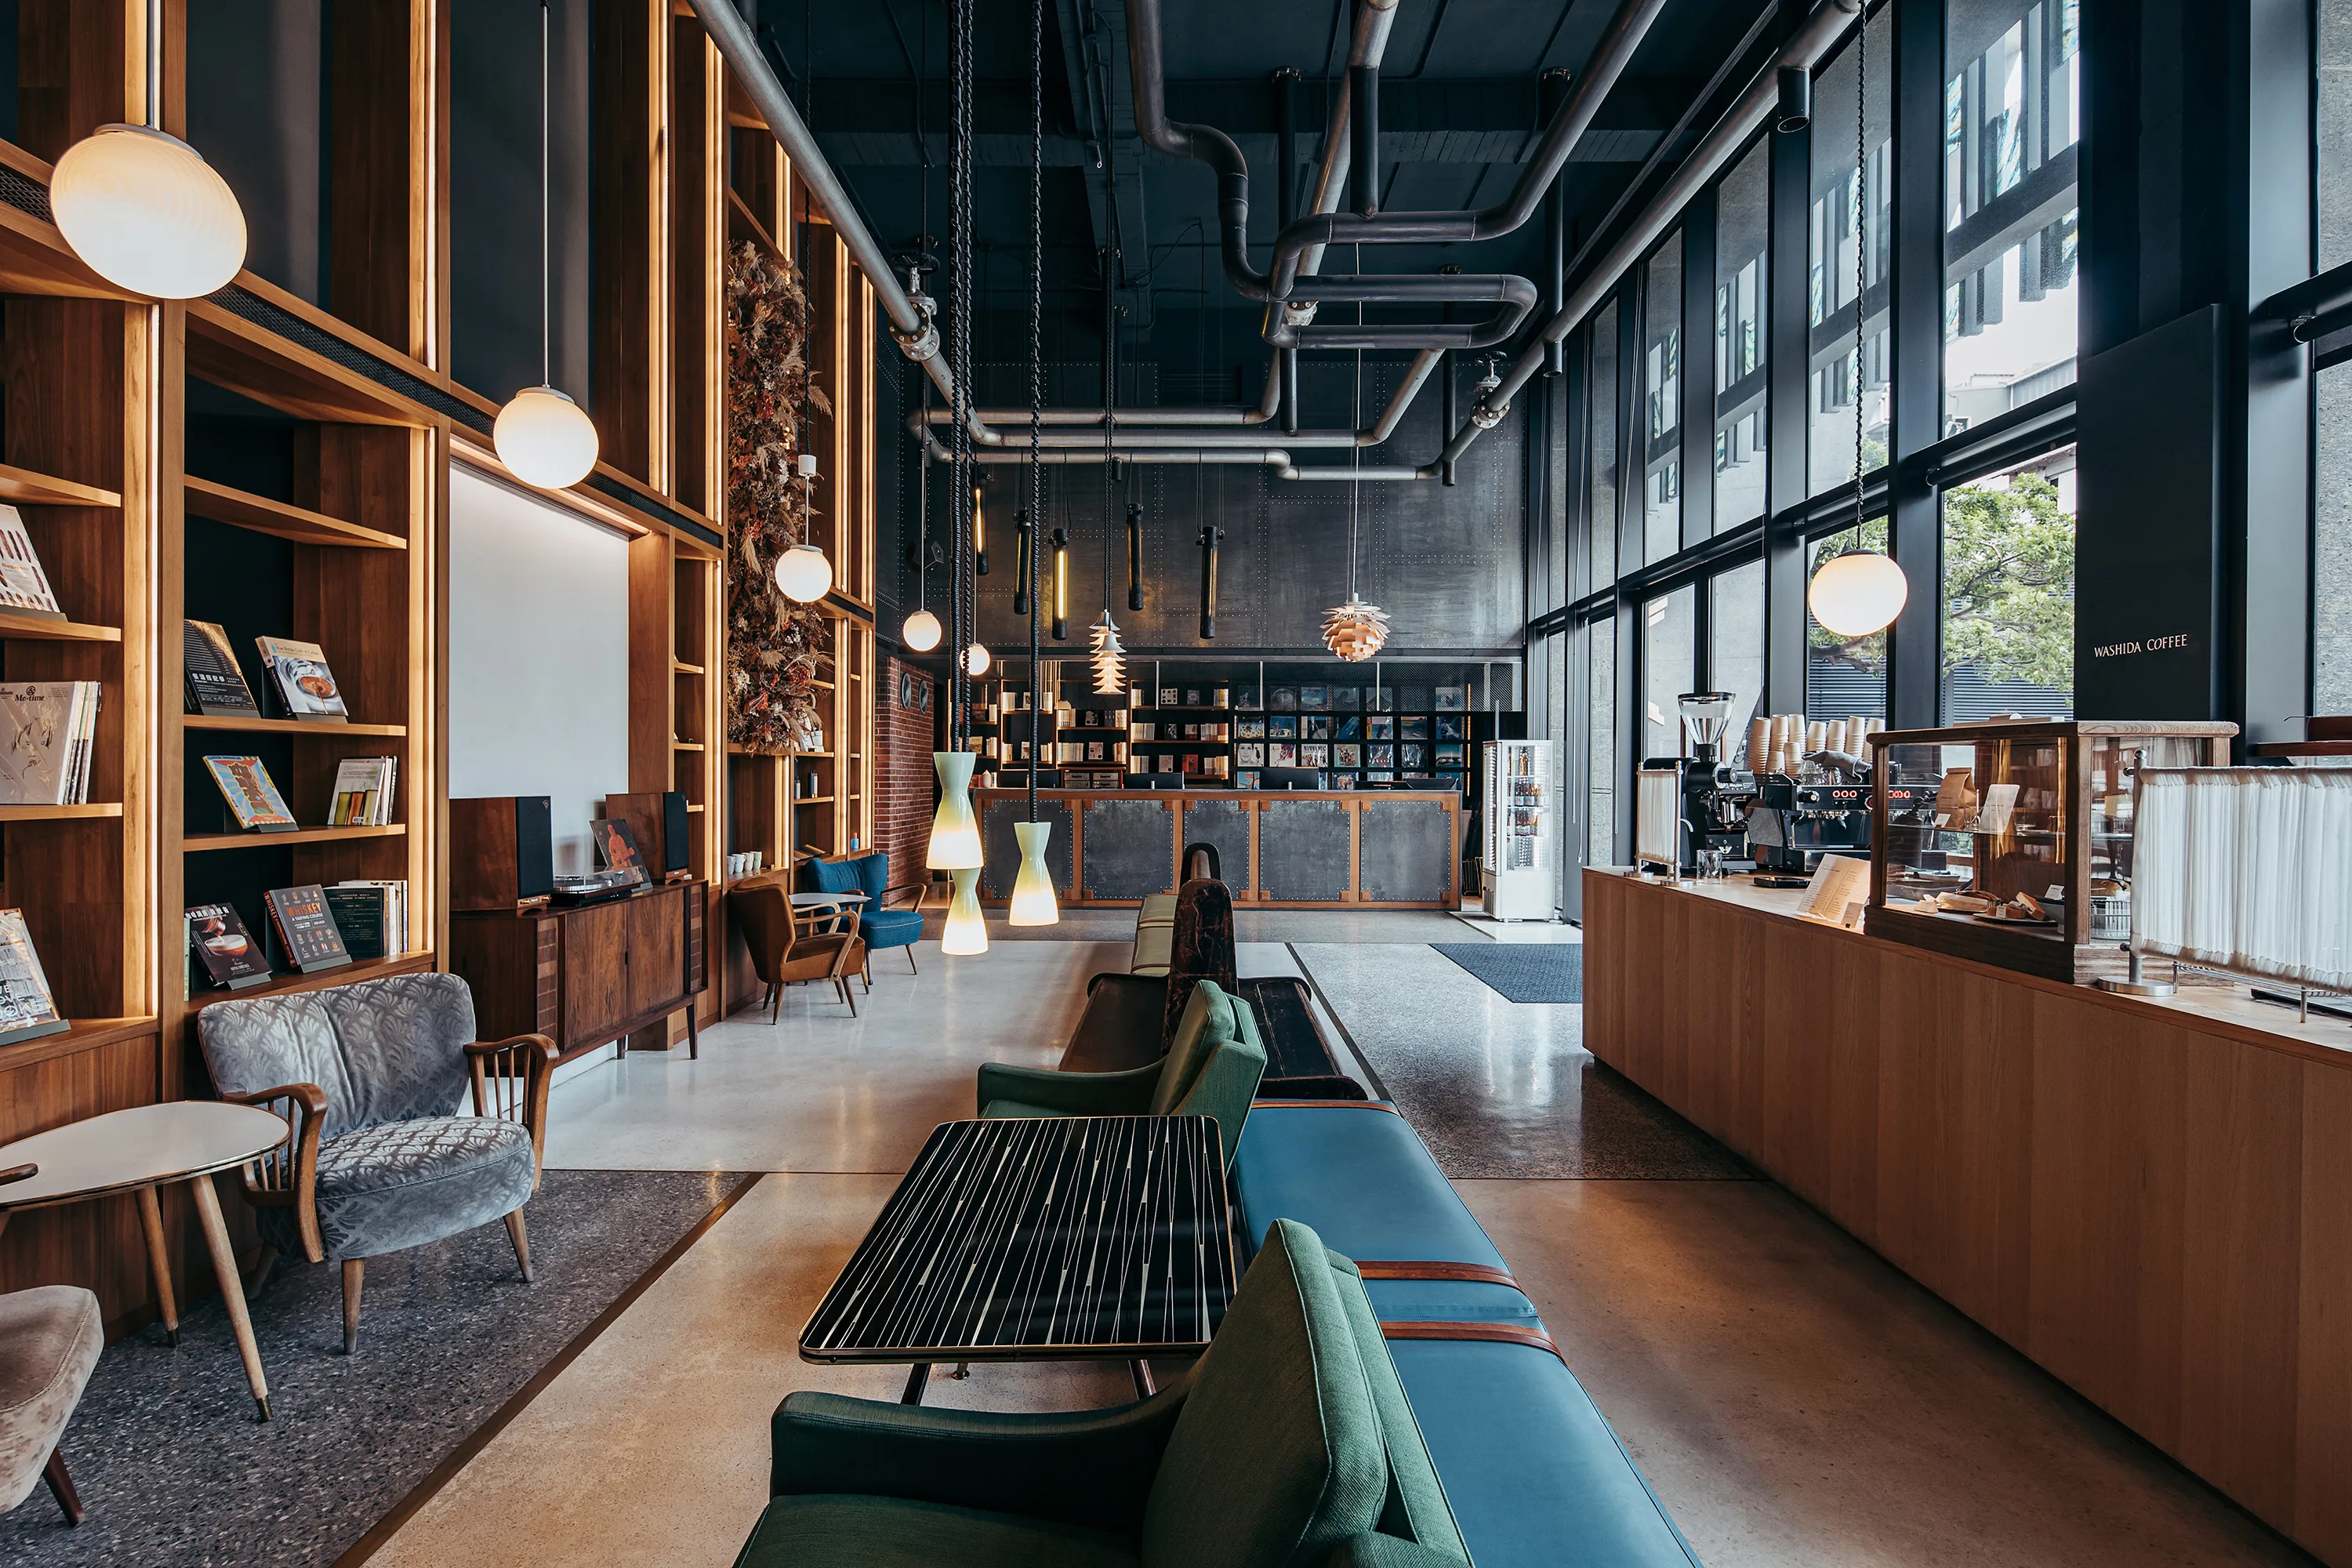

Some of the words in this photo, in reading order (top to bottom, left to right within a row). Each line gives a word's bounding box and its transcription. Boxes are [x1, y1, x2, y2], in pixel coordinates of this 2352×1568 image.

[2094, 641, 2142, 657] WASHIDA
[2147, 633, 2187, 651] COFFEE
[265, 894, 278, 919] WHISKEY
[286, 902, 321, 916] WHISKEY
